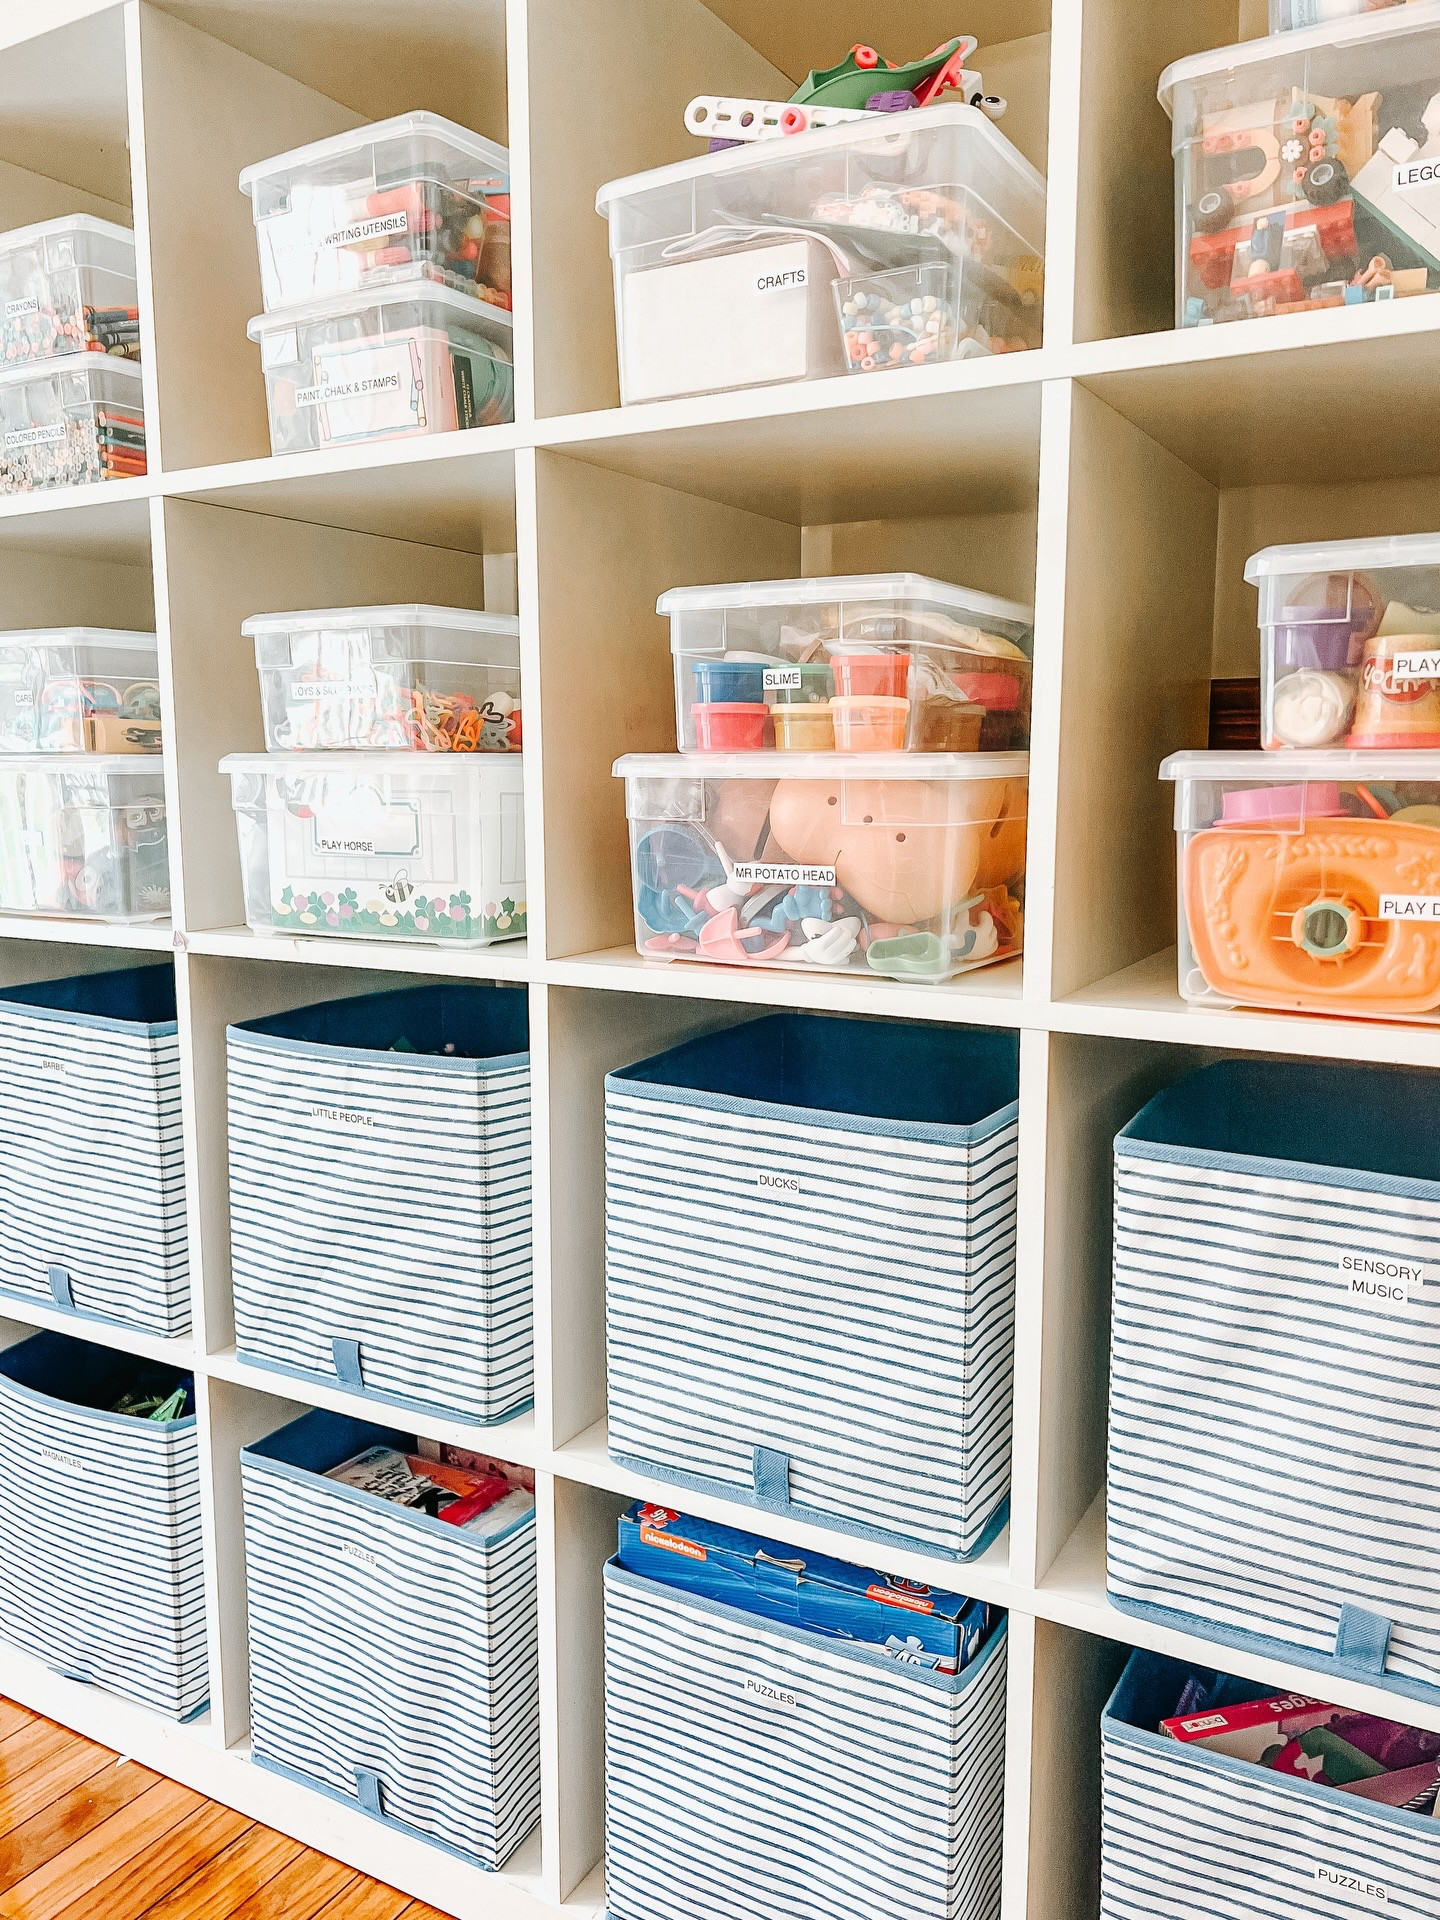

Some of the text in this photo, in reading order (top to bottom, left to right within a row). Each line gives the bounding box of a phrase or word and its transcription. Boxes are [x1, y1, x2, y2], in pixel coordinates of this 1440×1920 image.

[325, 216, 406, 245] WRITING UTENSILS
[757, 270, 805, 290] CRAFTS
[6, 299, 37, 315] CRAYONS
[297, 375, 397, 403] PAINT, CHALK & STAMPS
[6, 426, 65, 445] COLORED PENCILS
[1397, 658, 1440, 674] PLAY
[765, 672, 799, 686] SLIME
[15, 694, 33, 703] CARS
[315, 686, 321, 697] &
[321, 839, 373, 852] PLAY HORSE
[735, 867, 834, 882] MR POTATO HEAD
[1383, 901, 1426, 915] PLAY
[313, 1107, 372, 1126] LITTLE PEOPLE
[760, 1174, 798, 1191] DUCKS
[1342, 1256, 1421, 1281] SENSORY
[1352, 1280, 1404, 1300] MUSIC
[42, 1449, 82, 1469] MAGNATILES
[344, 1543, 375, 1565] PUZZLES
[645, 1532, 702, 1557] nickelodeon
[747, 1679, 795, 1705] PUZZLES
[1318, 1868, 1385, 1899] PUZZLES
